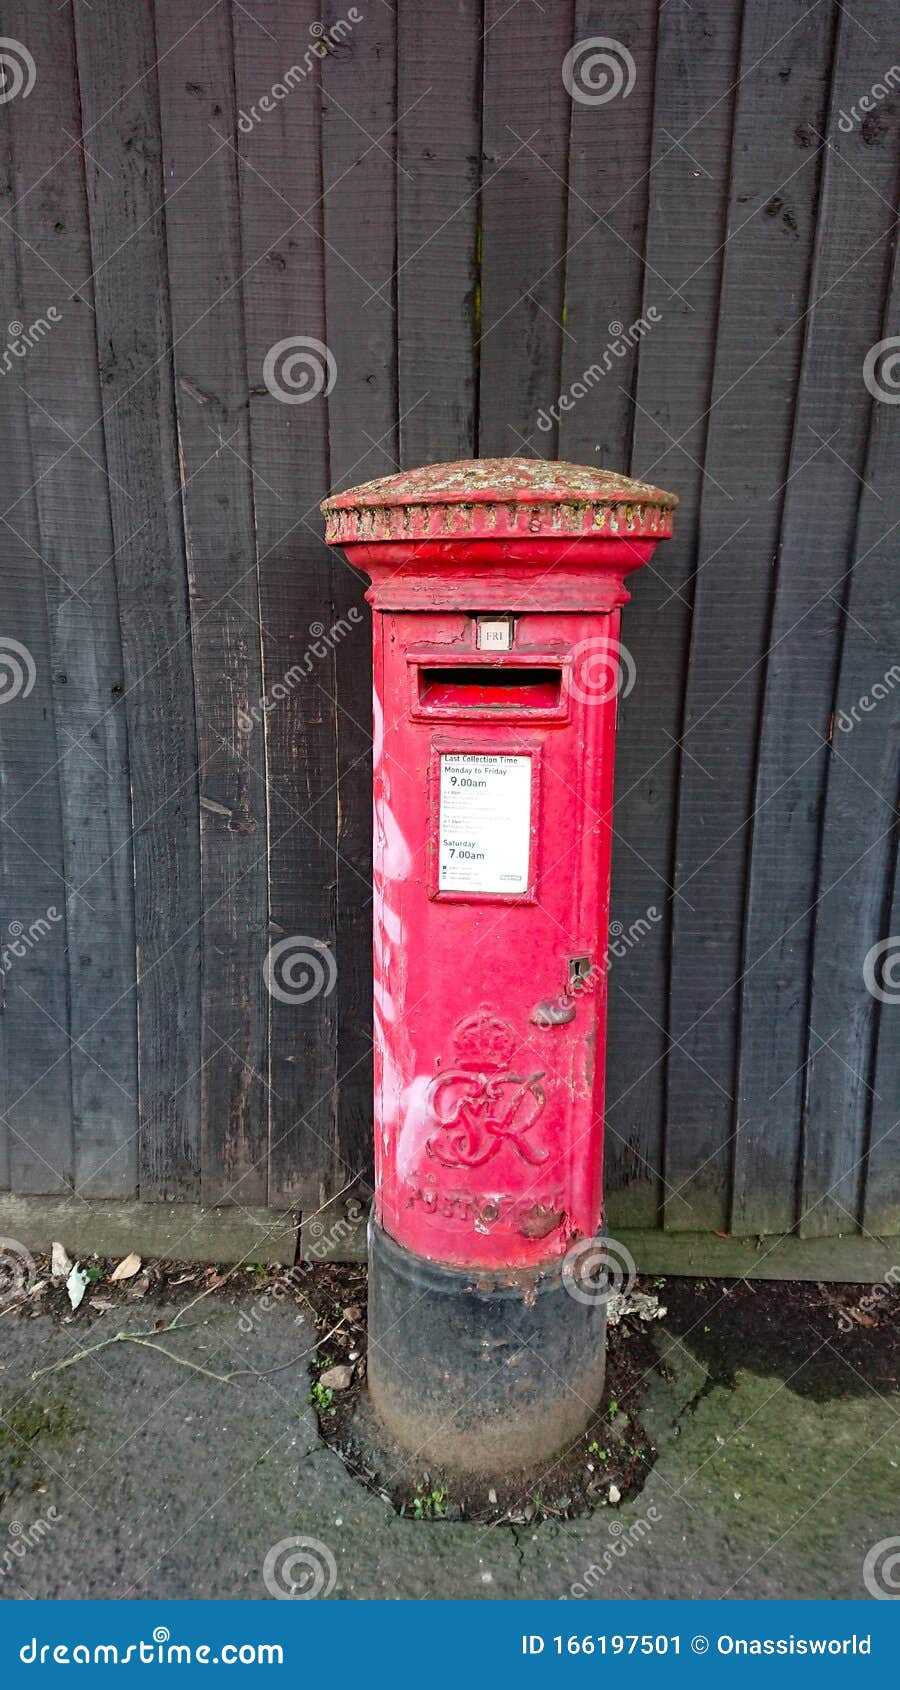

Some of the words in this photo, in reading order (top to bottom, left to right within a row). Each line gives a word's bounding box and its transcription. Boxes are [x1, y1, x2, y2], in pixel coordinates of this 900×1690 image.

[486, 631, 504, 641] FRI
[444, 754, 460, 762] Last
[462, 755, 498, 763] Collection
[499, 756, 518, 764] Time
[444, 766, 472, 775] Monday
[484, 767, 507, 776] Friday
[450, 776, 487, 787] 9.00am
[443, 839, 476, 848] Saturday
[449, 848, 485, 860] 7.00am
